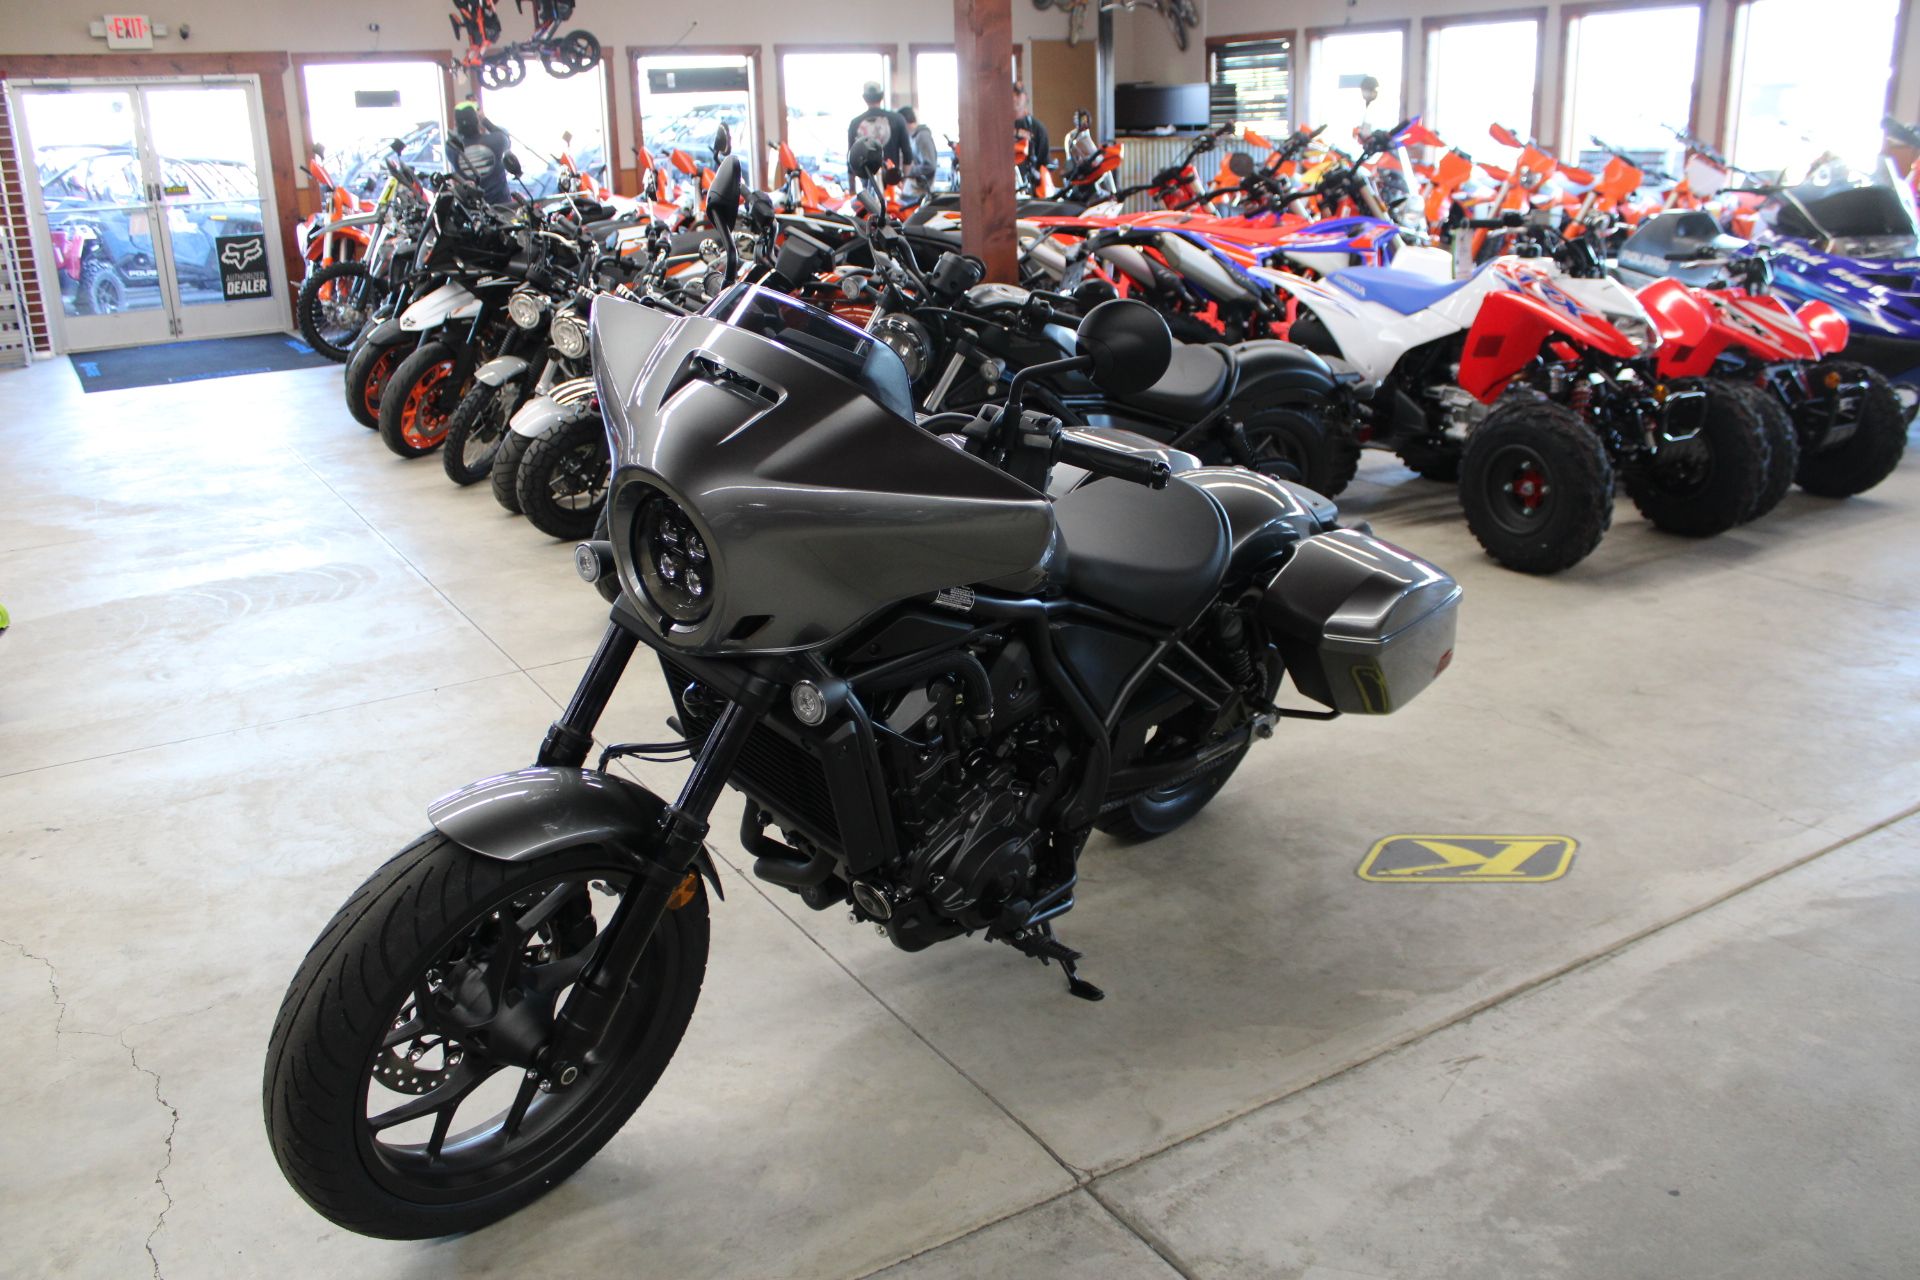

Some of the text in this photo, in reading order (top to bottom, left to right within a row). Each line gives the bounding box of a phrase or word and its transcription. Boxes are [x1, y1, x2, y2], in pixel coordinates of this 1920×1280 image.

[113, 16, 143, 39] EXIT
[226, 271, 265, 282] AUTHORIZED
[1334, 273, 1366, 297] HONDA
[227, 279, 267, 296] DEALER
